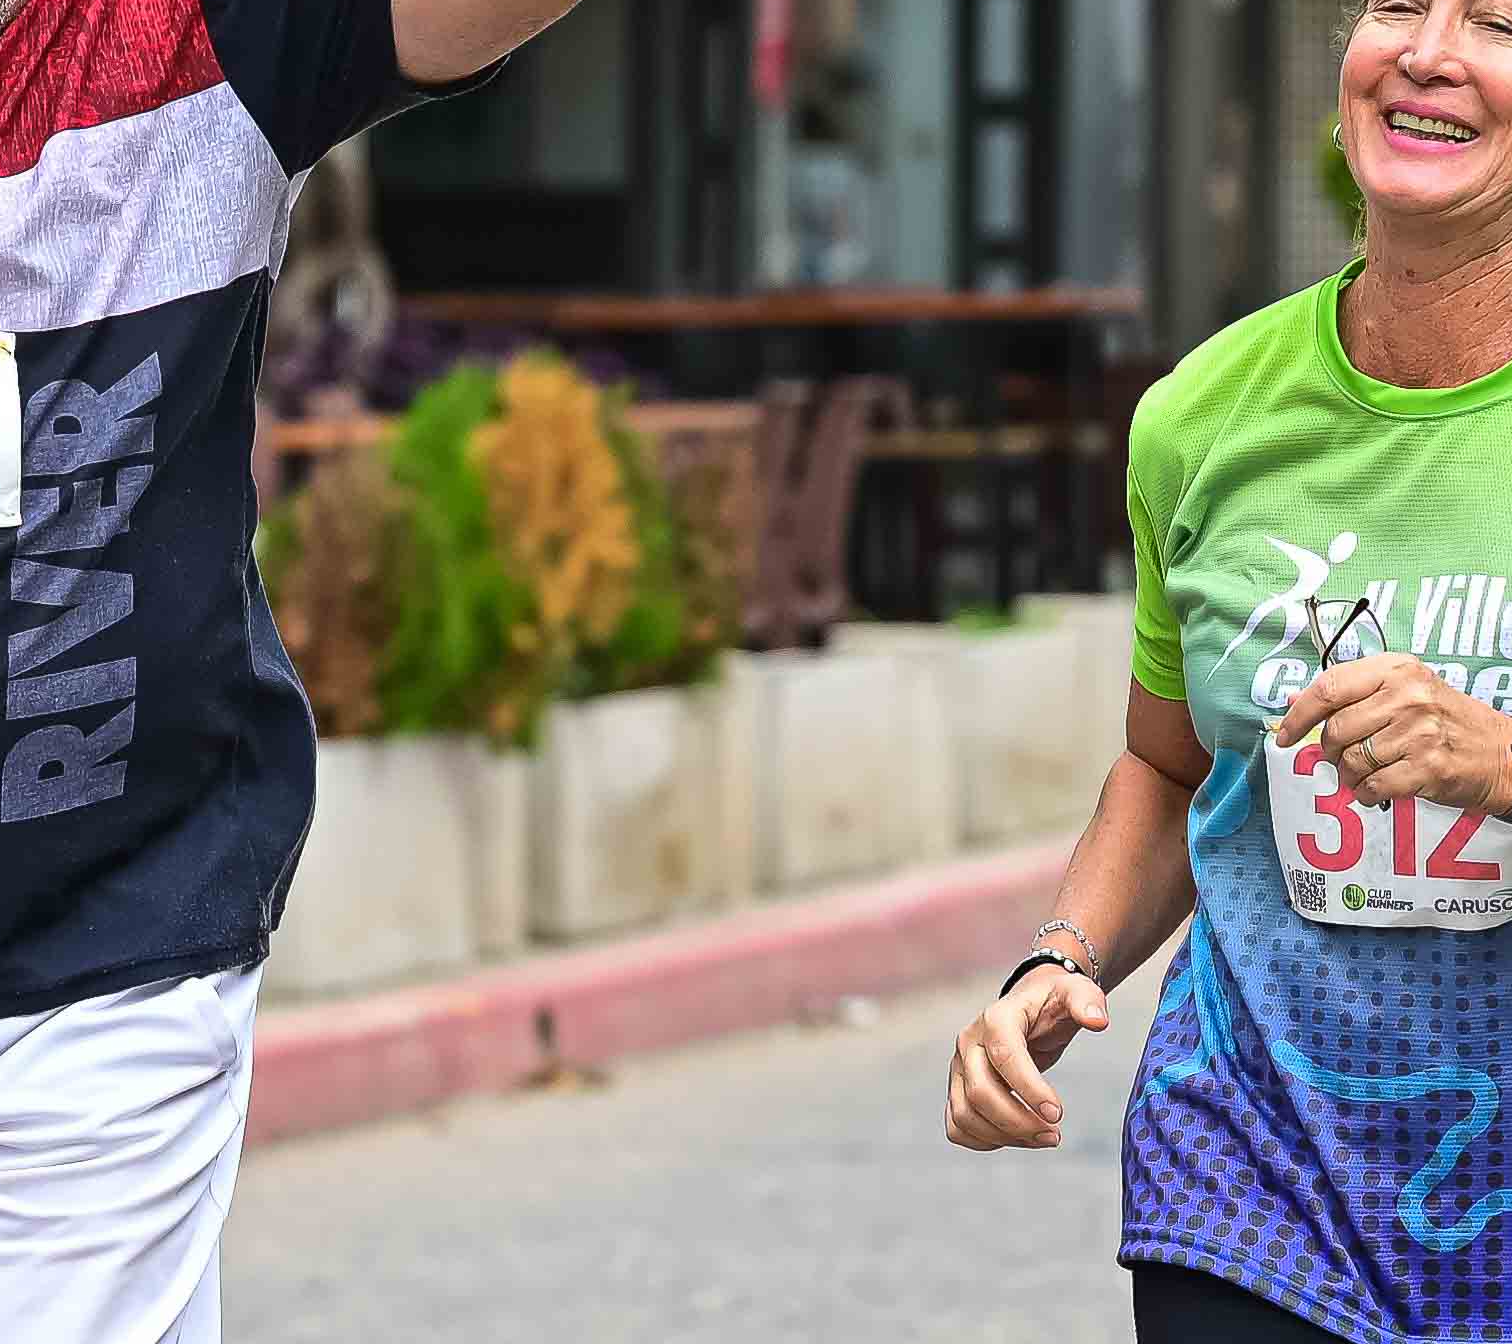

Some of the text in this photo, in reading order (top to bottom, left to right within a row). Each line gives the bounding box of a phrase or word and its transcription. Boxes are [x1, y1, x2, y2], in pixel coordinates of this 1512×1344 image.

[0, 350, 164, 824] RIVER
[1293, 743, 1501, 881] 312
[1366, 899, 1414, 912] RUNNER'S
[1367, 888, 1392, 899] CLUB
